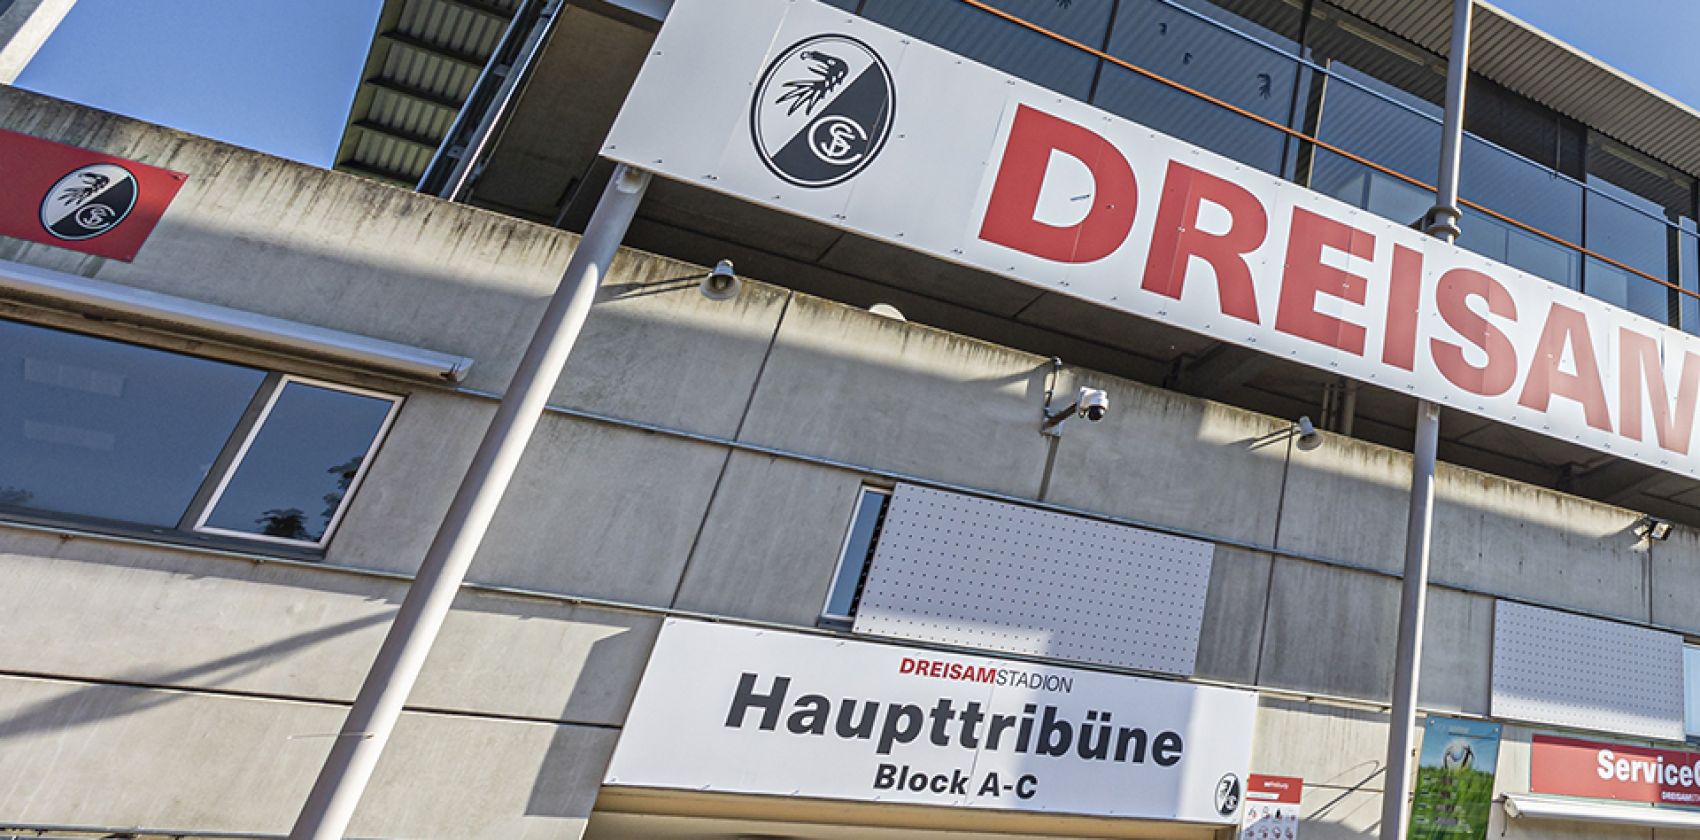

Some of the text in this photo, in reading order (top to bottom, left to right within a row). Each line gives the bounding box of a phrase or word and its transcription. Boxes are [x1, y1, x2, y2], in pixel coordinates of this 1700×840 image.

[899, 657, 1074, 694] DREISAMSTADION
[725, 672, 1184, 766] Haupttribüne
[873, 763, 1039, 800] Block A-C
